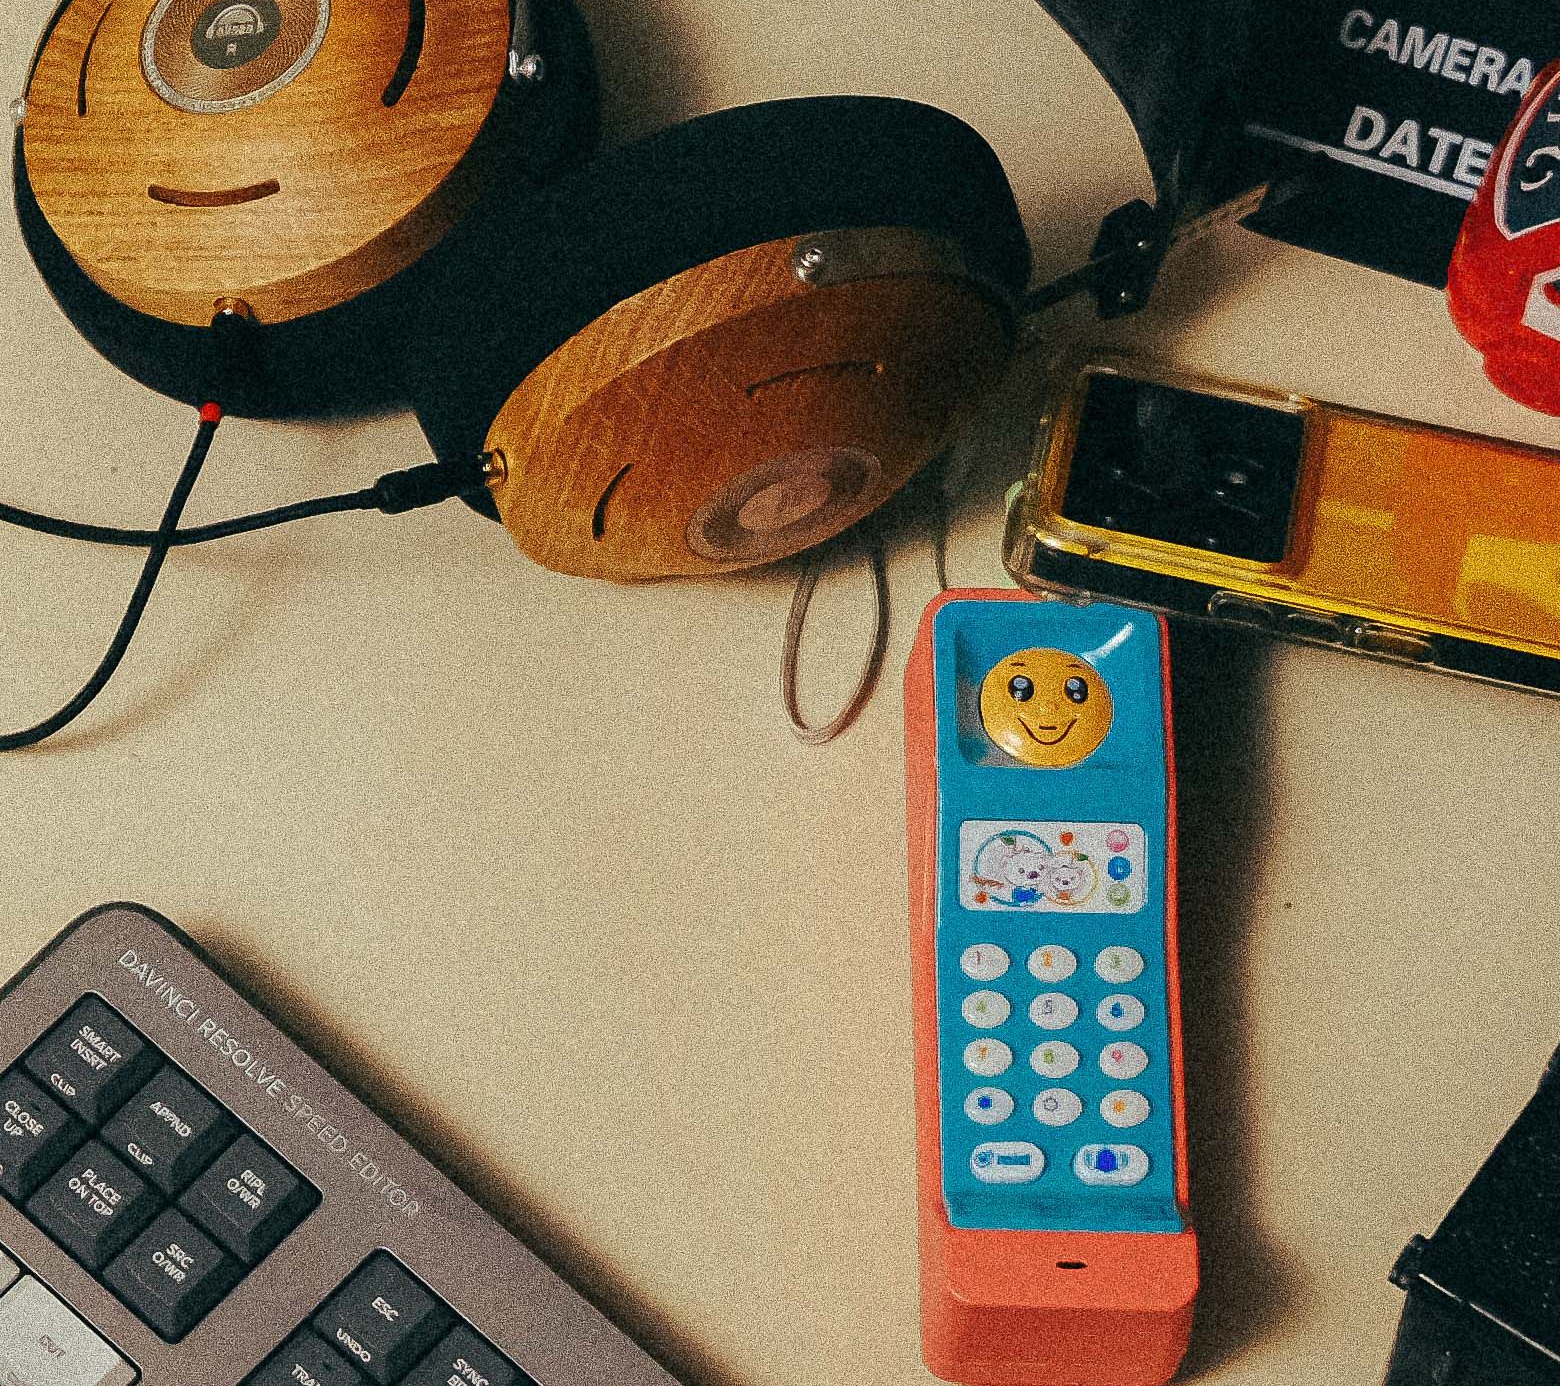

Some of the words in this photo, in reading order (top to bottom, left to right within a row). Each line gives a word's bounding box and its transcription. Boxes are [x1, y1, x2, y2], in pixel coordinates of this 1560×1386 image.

[1338, 9, 1536, 101] CAMERA
[1343, 104, 1494, 187] DATE
[68, 1037, 108, 1074] INSRT
[77, 1023, 123, 1065] SMART
[47, 1070, 79, 1100] CLIP
[116, 948, 201, 1025] DAVINCI
[196, 1018, 285, 1098] RESOLVE
[281, 1093, 352, 1157] SPEED
[346, 1151, 422, 1220] EDITOR
[1, 1097, 45, 1138] CLOSE
[1, 1118, 24, 1141] UP
[148, 1098, 194, 1141] APPND
[124, 1140, 155, 1169] CLIP
[65, 1175, 89, 1199] ON
[84, 1192, 115, 1221] TOP
[79, 1167, 123, 1207] PLACE
[164, 1241, 195, 1270] SRC
[370, 1294, 400, 1323] ESC
[332, 1327, 374, 1365] UNDO
